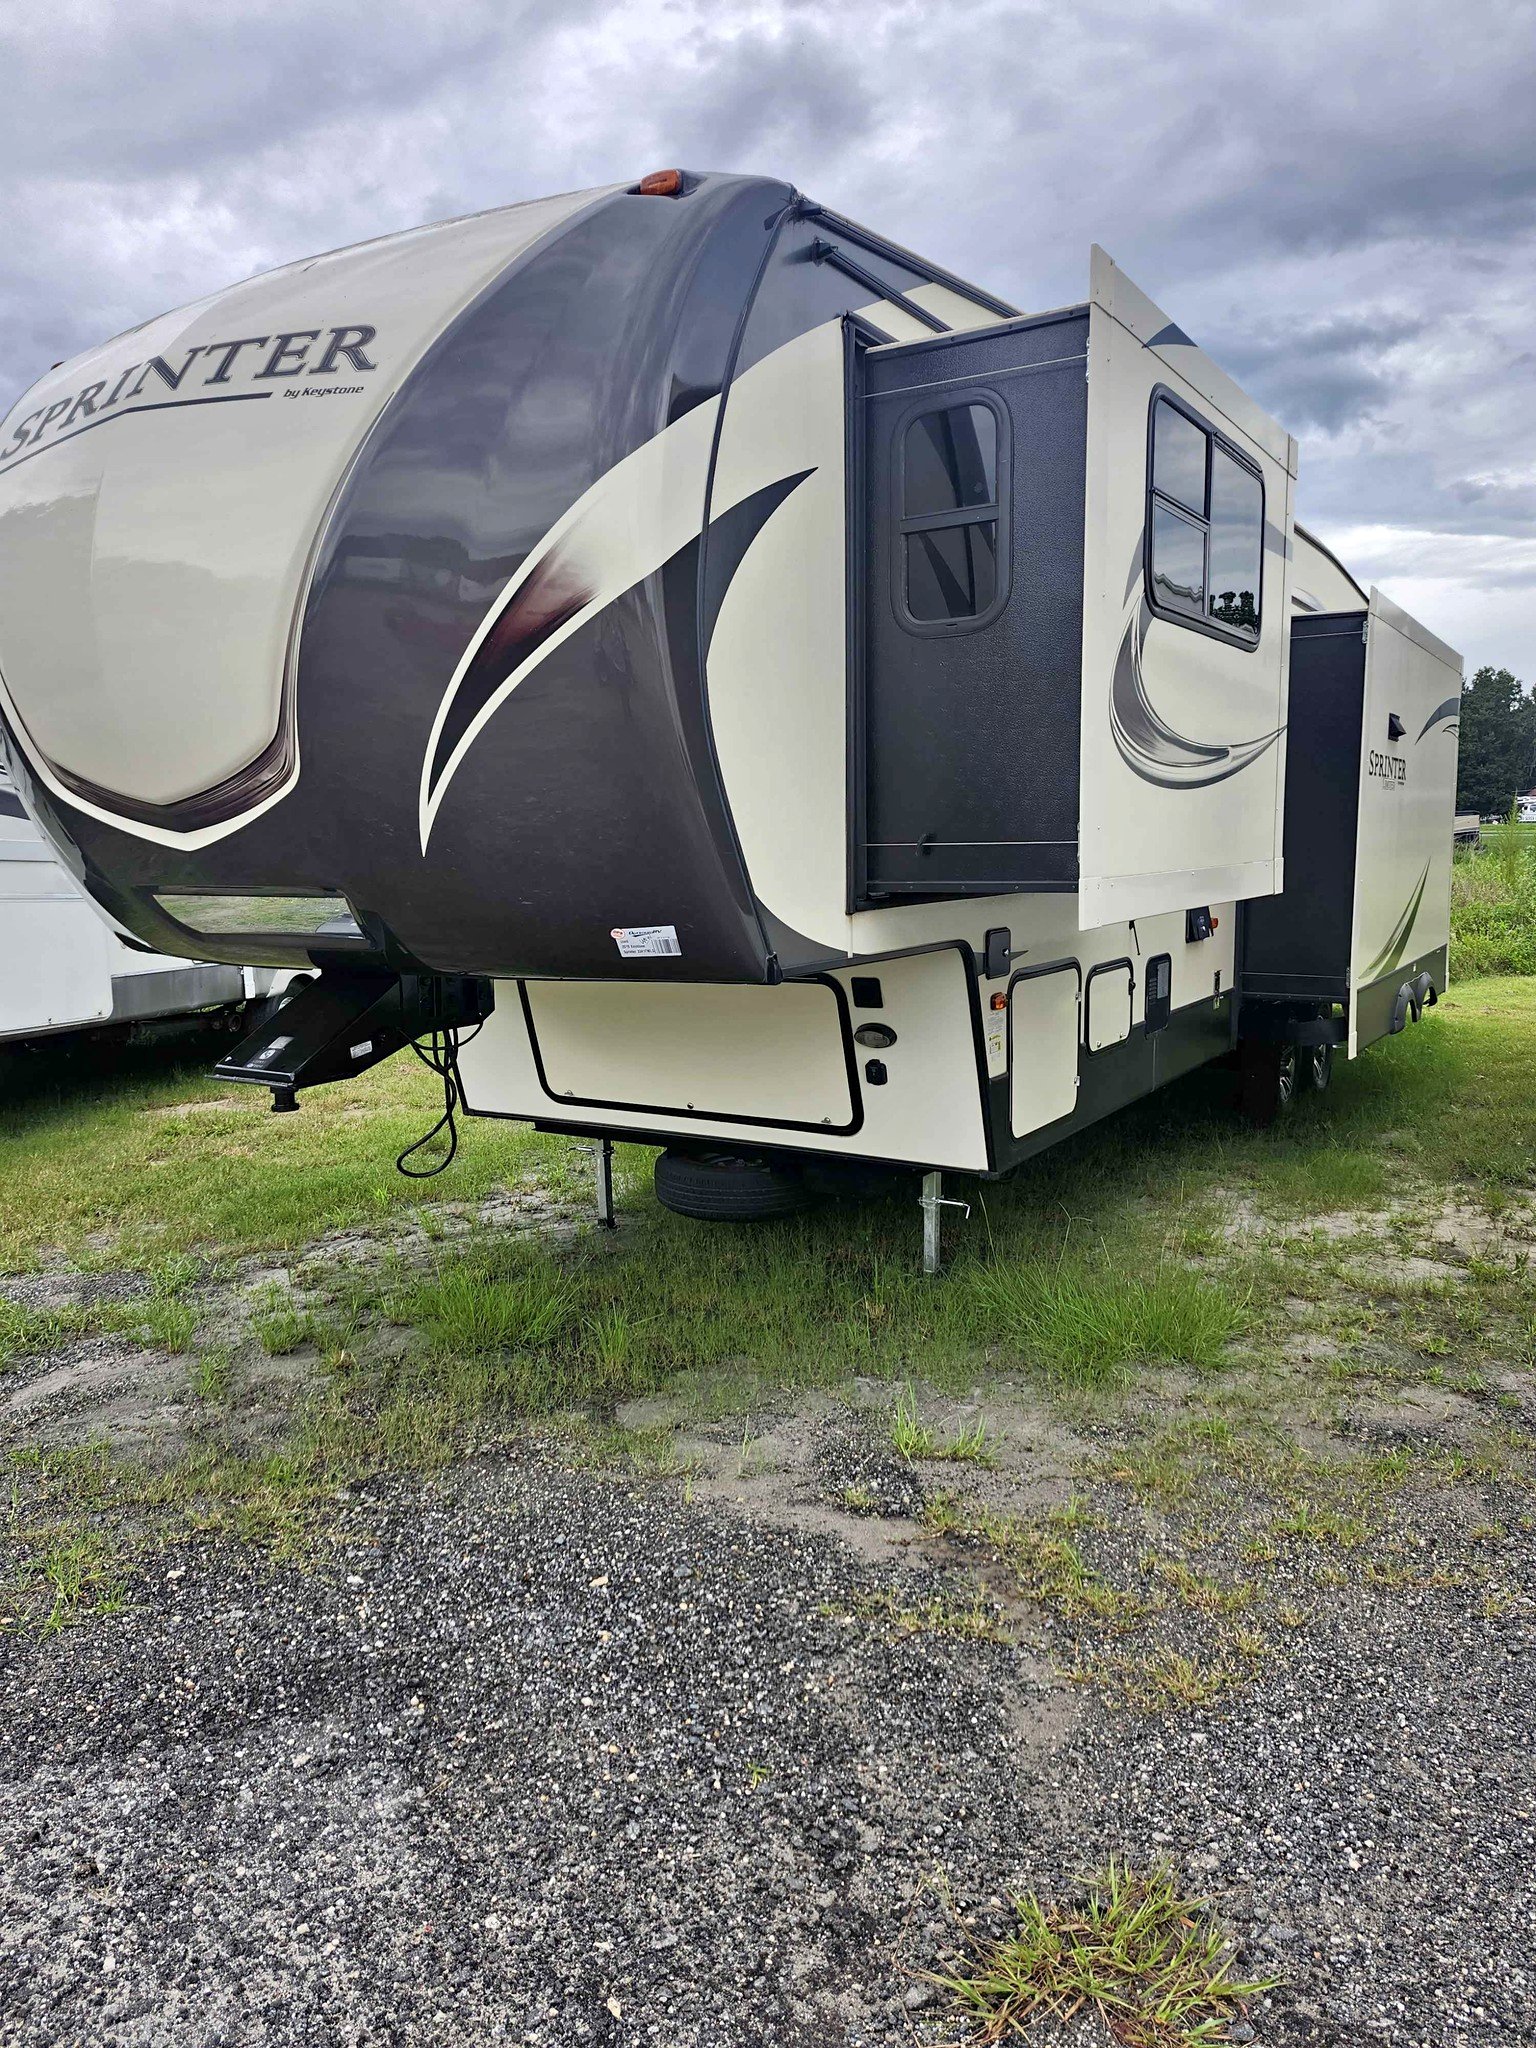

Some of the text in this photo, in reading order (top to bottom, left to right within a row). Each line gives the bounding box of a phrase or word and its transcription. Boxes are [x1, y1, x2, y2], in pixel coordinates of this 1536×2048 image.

[1, 325, 377, 459] SPRINTER
[283, 386, 364, 399] by Keystone
[1369, 750, 1406, 780] SPRINTER
